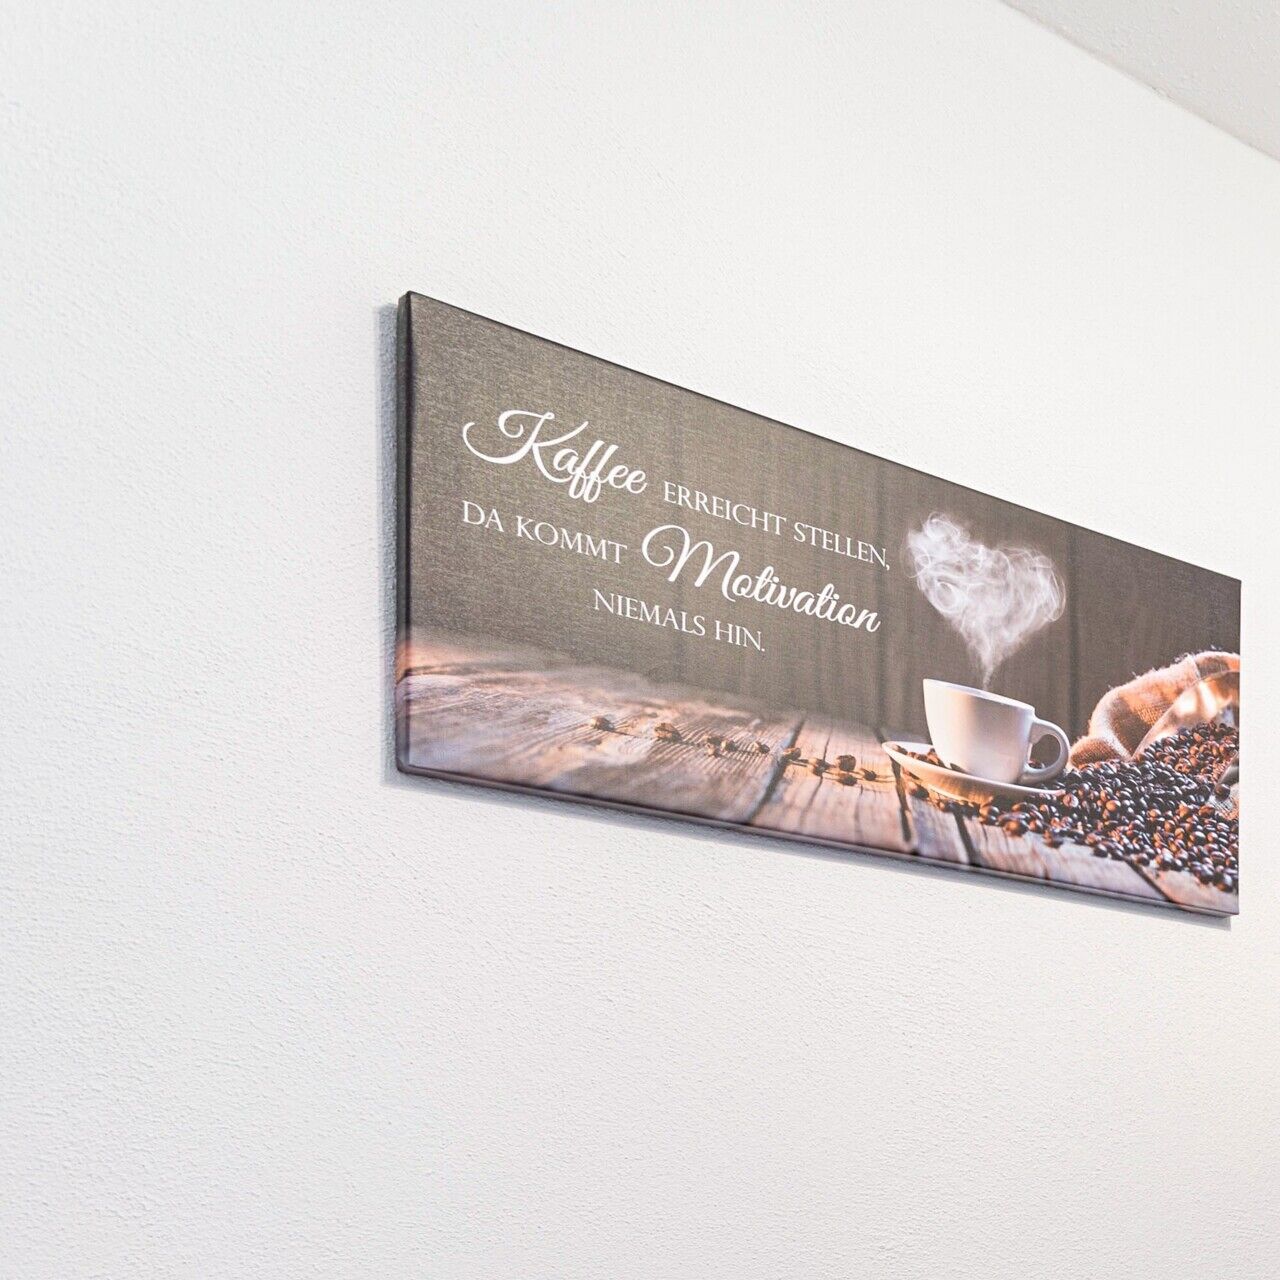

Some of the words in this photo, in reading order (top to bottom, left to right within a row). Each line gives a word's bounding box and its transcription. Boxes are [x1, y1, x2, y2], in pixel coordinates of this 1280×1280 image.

[462, 409, 648, 503] Kaffee
[663, 481, 787, 537] ERREICHT
[793, 521, 891, 572] STELLEN,
[462, 500, 505, 533] DA
[516, 515, 628, 564] KOMMT
[641, 524, 882, 634] Motivation
[593, 588, 706, 637] NIEMALS
[714, 619, 766, 652] HIN.
